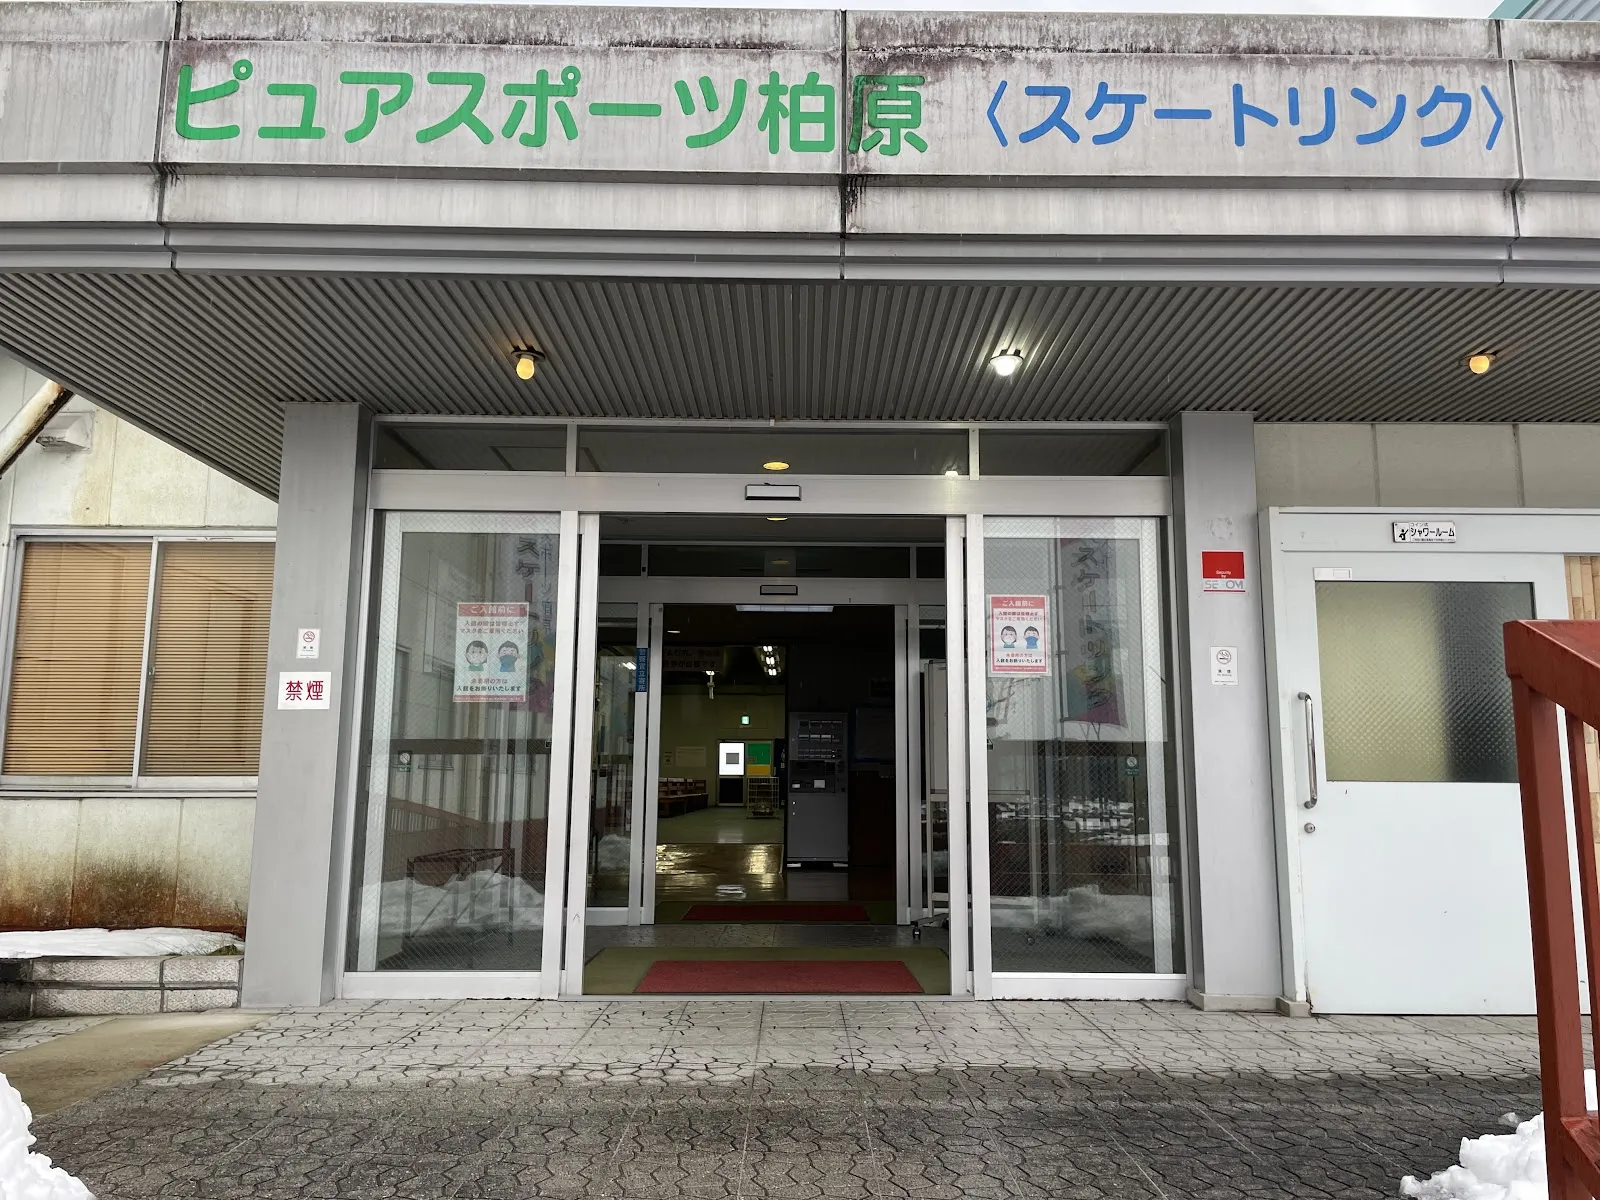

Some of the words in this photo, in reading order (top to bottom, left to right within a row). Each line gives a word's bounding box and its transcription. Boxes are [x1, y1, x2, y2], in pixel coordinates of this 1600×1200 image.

[175, 59, 928, 156] ピュアスポーツ柏原
[1410, 527, 1455, 537] シャワールーム
[1205, 580, 1244, 589] SEOM
[285, 680, 324, 701] 禁煙
